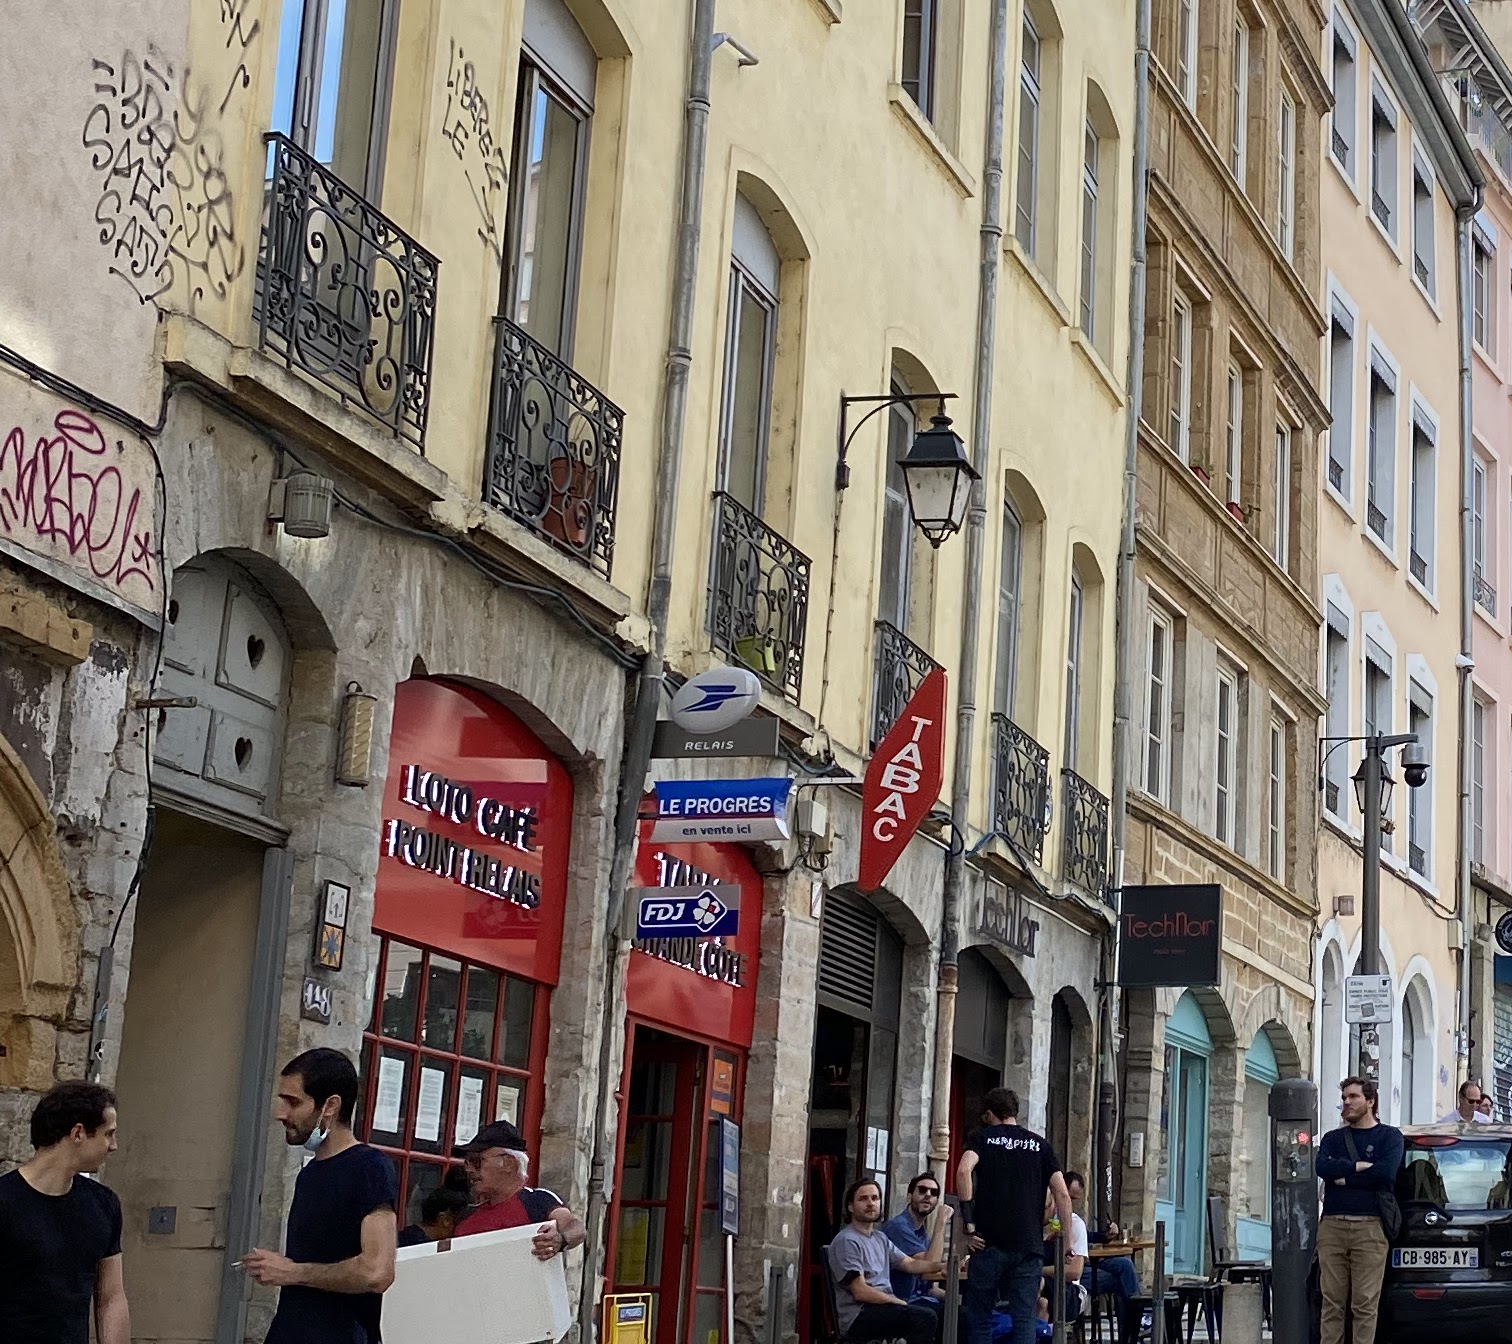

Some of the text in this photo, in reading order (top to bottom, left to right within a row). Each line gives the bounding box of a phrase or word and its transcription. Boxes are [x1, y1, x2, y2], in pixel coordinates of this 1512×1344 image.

[684, 740, 734, 751] RELAIS
[873, 715, 932, 842] TABAC
[402, 765, 473, 824] LOTO
[659, 799, 682, 815] LE
[682, 824, 752, 836] en vente ici
[384, 818, 541, 910] POINT RELAIS
[644, 903, 686, 921] FDJ
